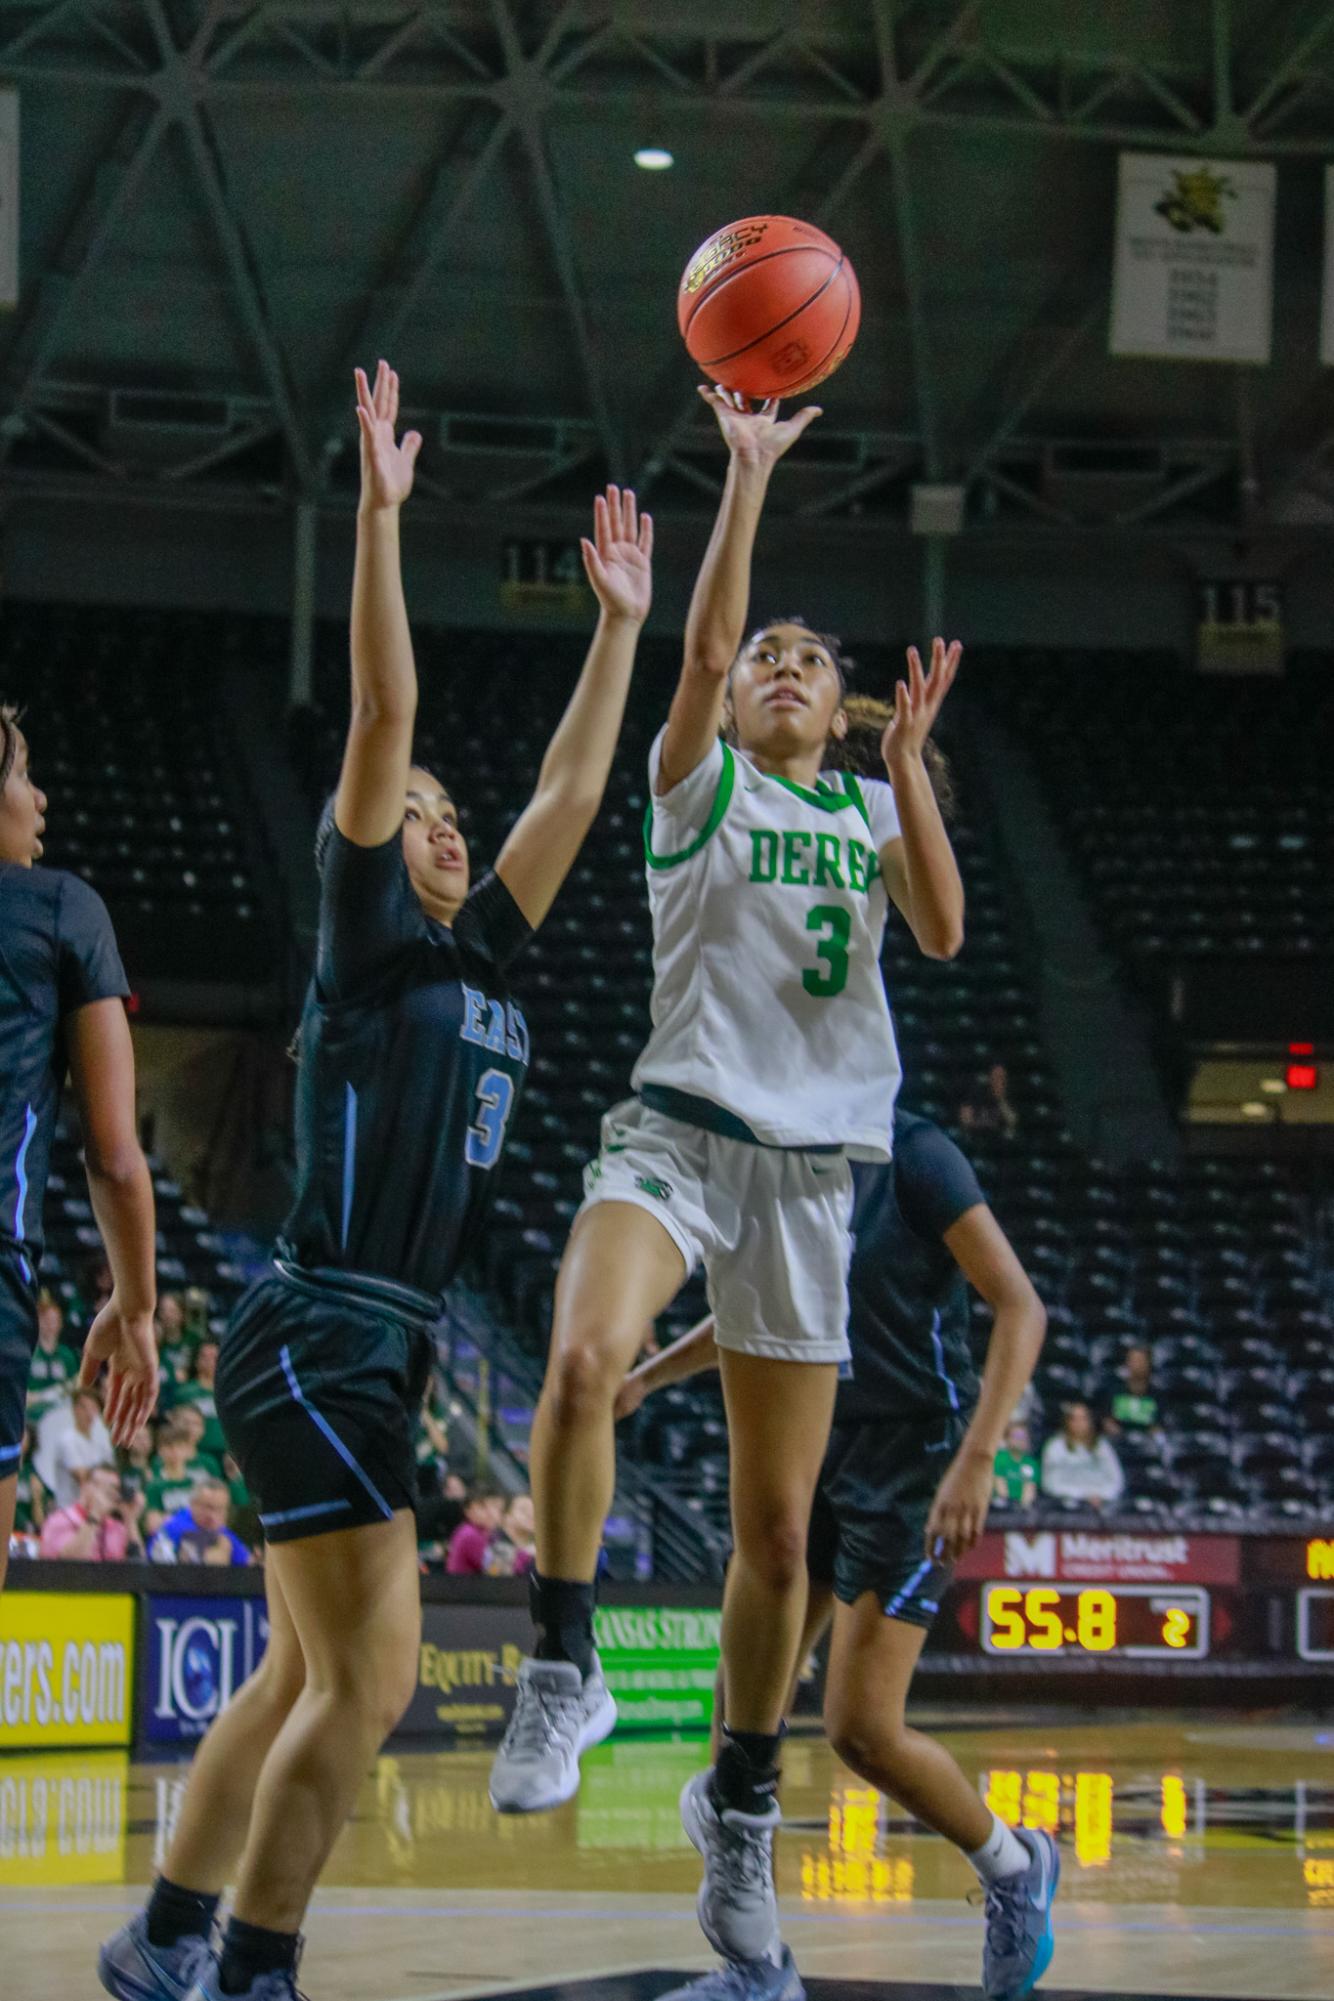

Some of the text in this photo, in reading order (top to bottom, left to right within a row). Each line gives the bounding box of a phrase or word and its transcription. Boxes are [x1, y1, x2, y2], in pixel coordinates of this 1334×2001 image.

[506, 546, 578, 588] 114
[1203, 586, 1281, 632] 115
[749, 829, 883, 894] DERB
[803, 904, 850, 997] 3
[465, 1068, 514, 1170] 3
[1061, 1533, 1188, 1564] Meritrust
[987, 1587, 1117, 1651] 55.8
[1162, 1608, 1190, 1648] 2
[0, 1639, 126, 1725] ers.com
